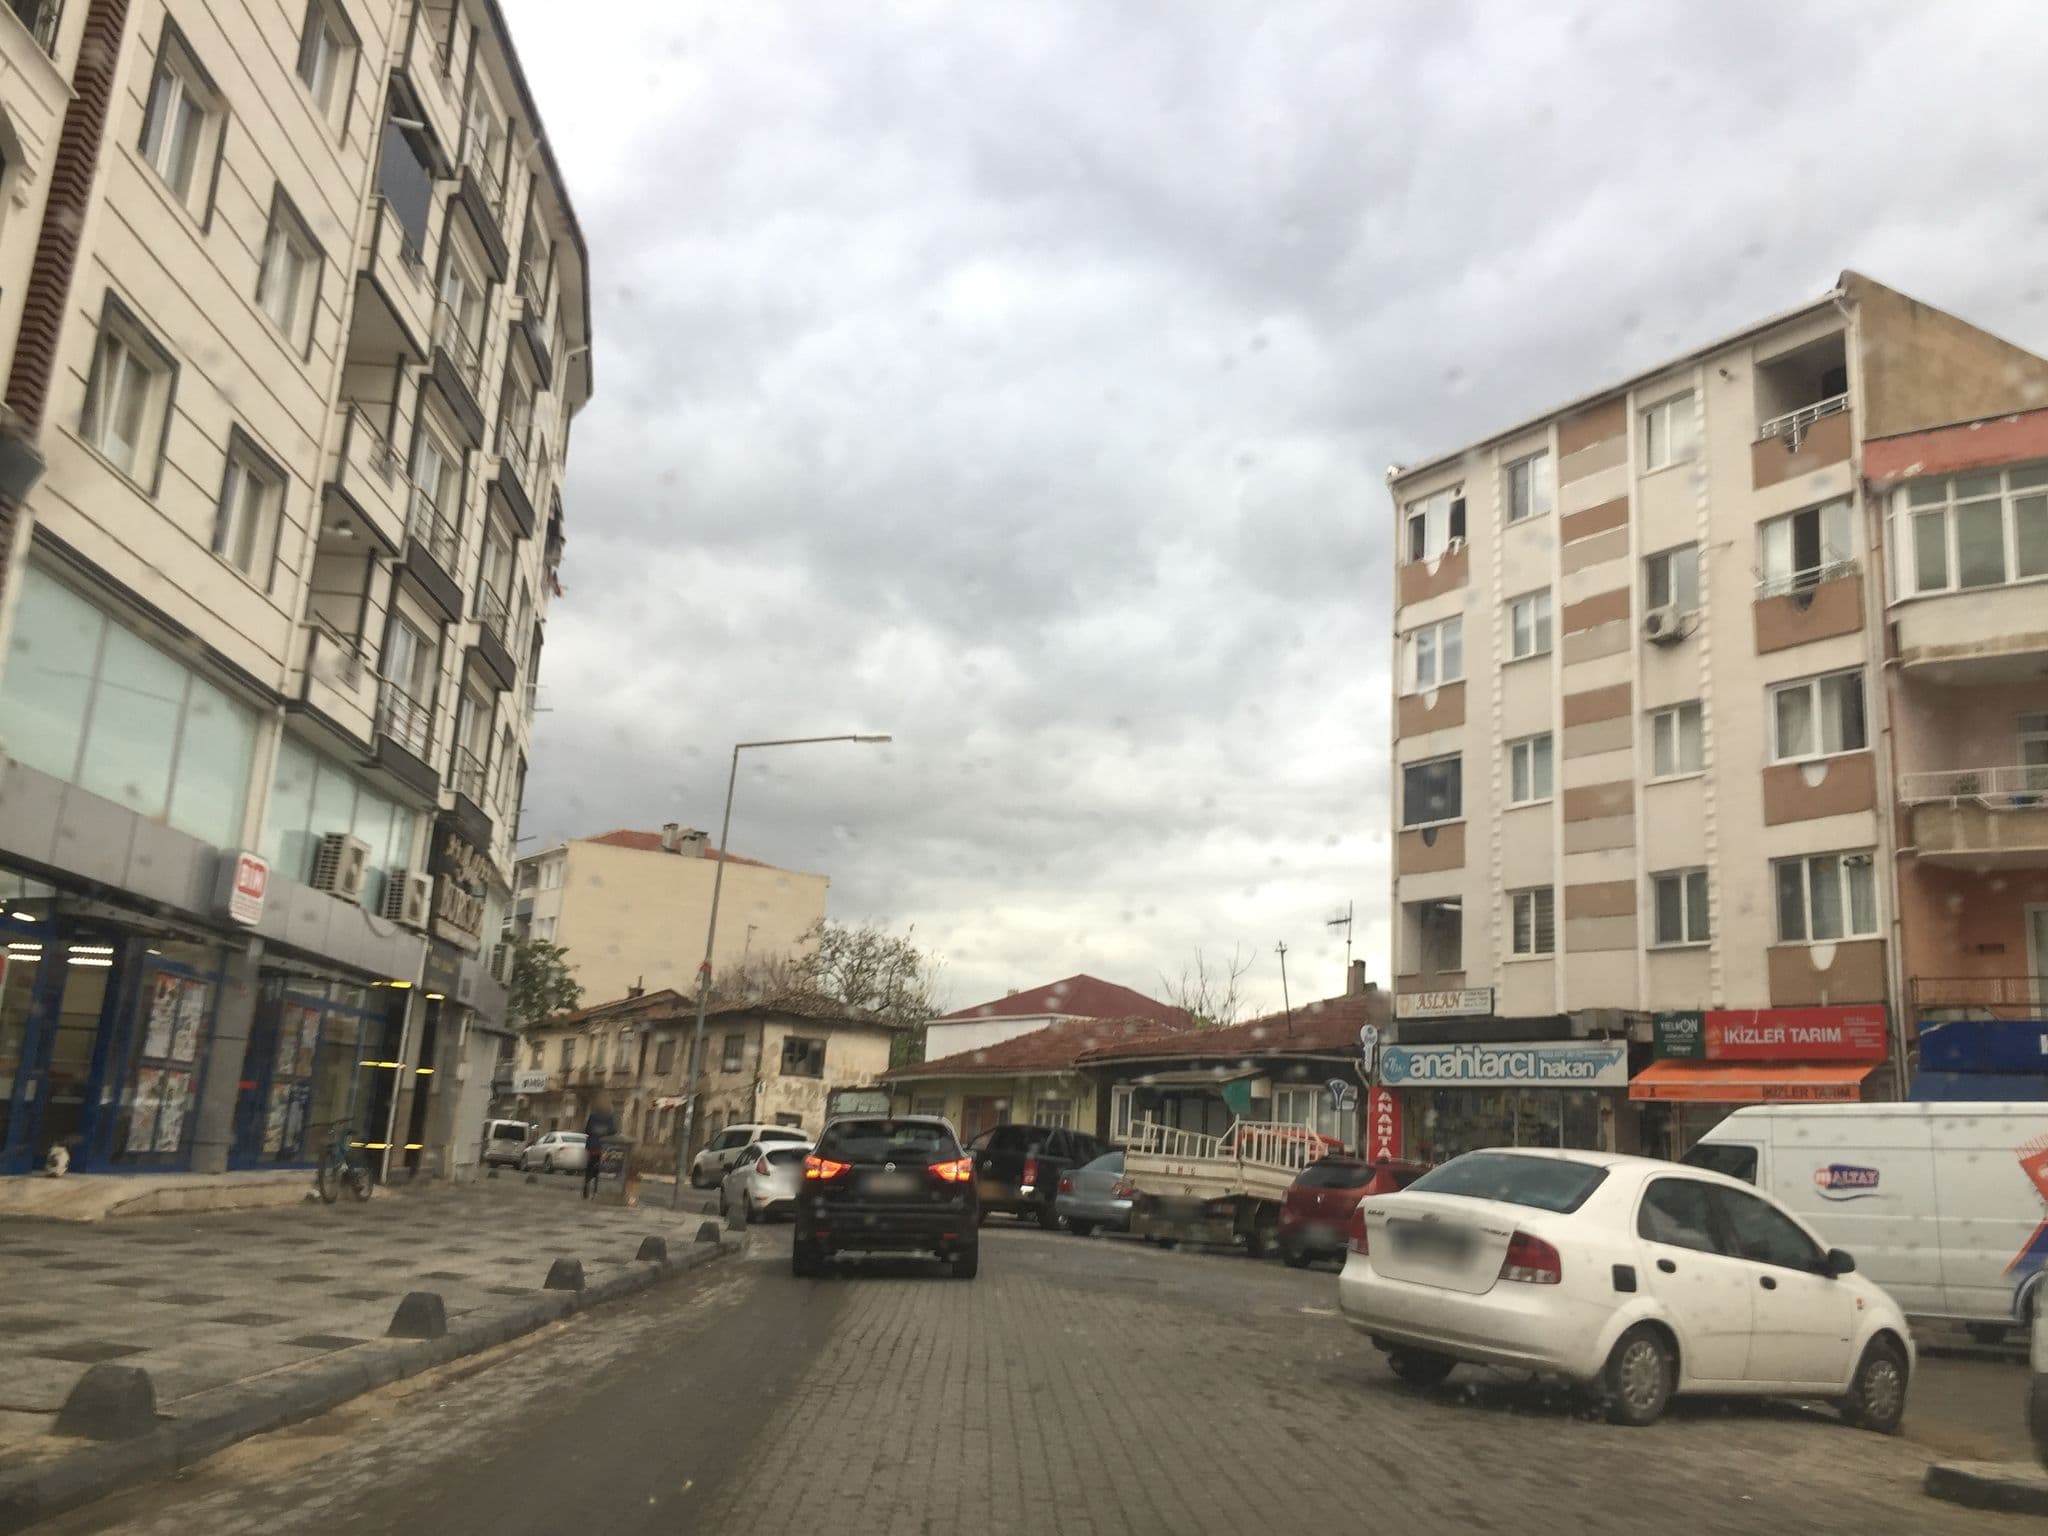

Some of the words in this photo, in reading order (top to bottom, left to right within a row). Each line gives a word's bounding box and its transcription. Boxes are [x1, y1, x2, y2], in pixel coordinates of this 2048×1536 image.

[1724, 1025, 1785, 1044] İKİZLER
[1789, 1027, 1841, 1043] TARIM
[1540, 1058, 1595, 1078] hakan
